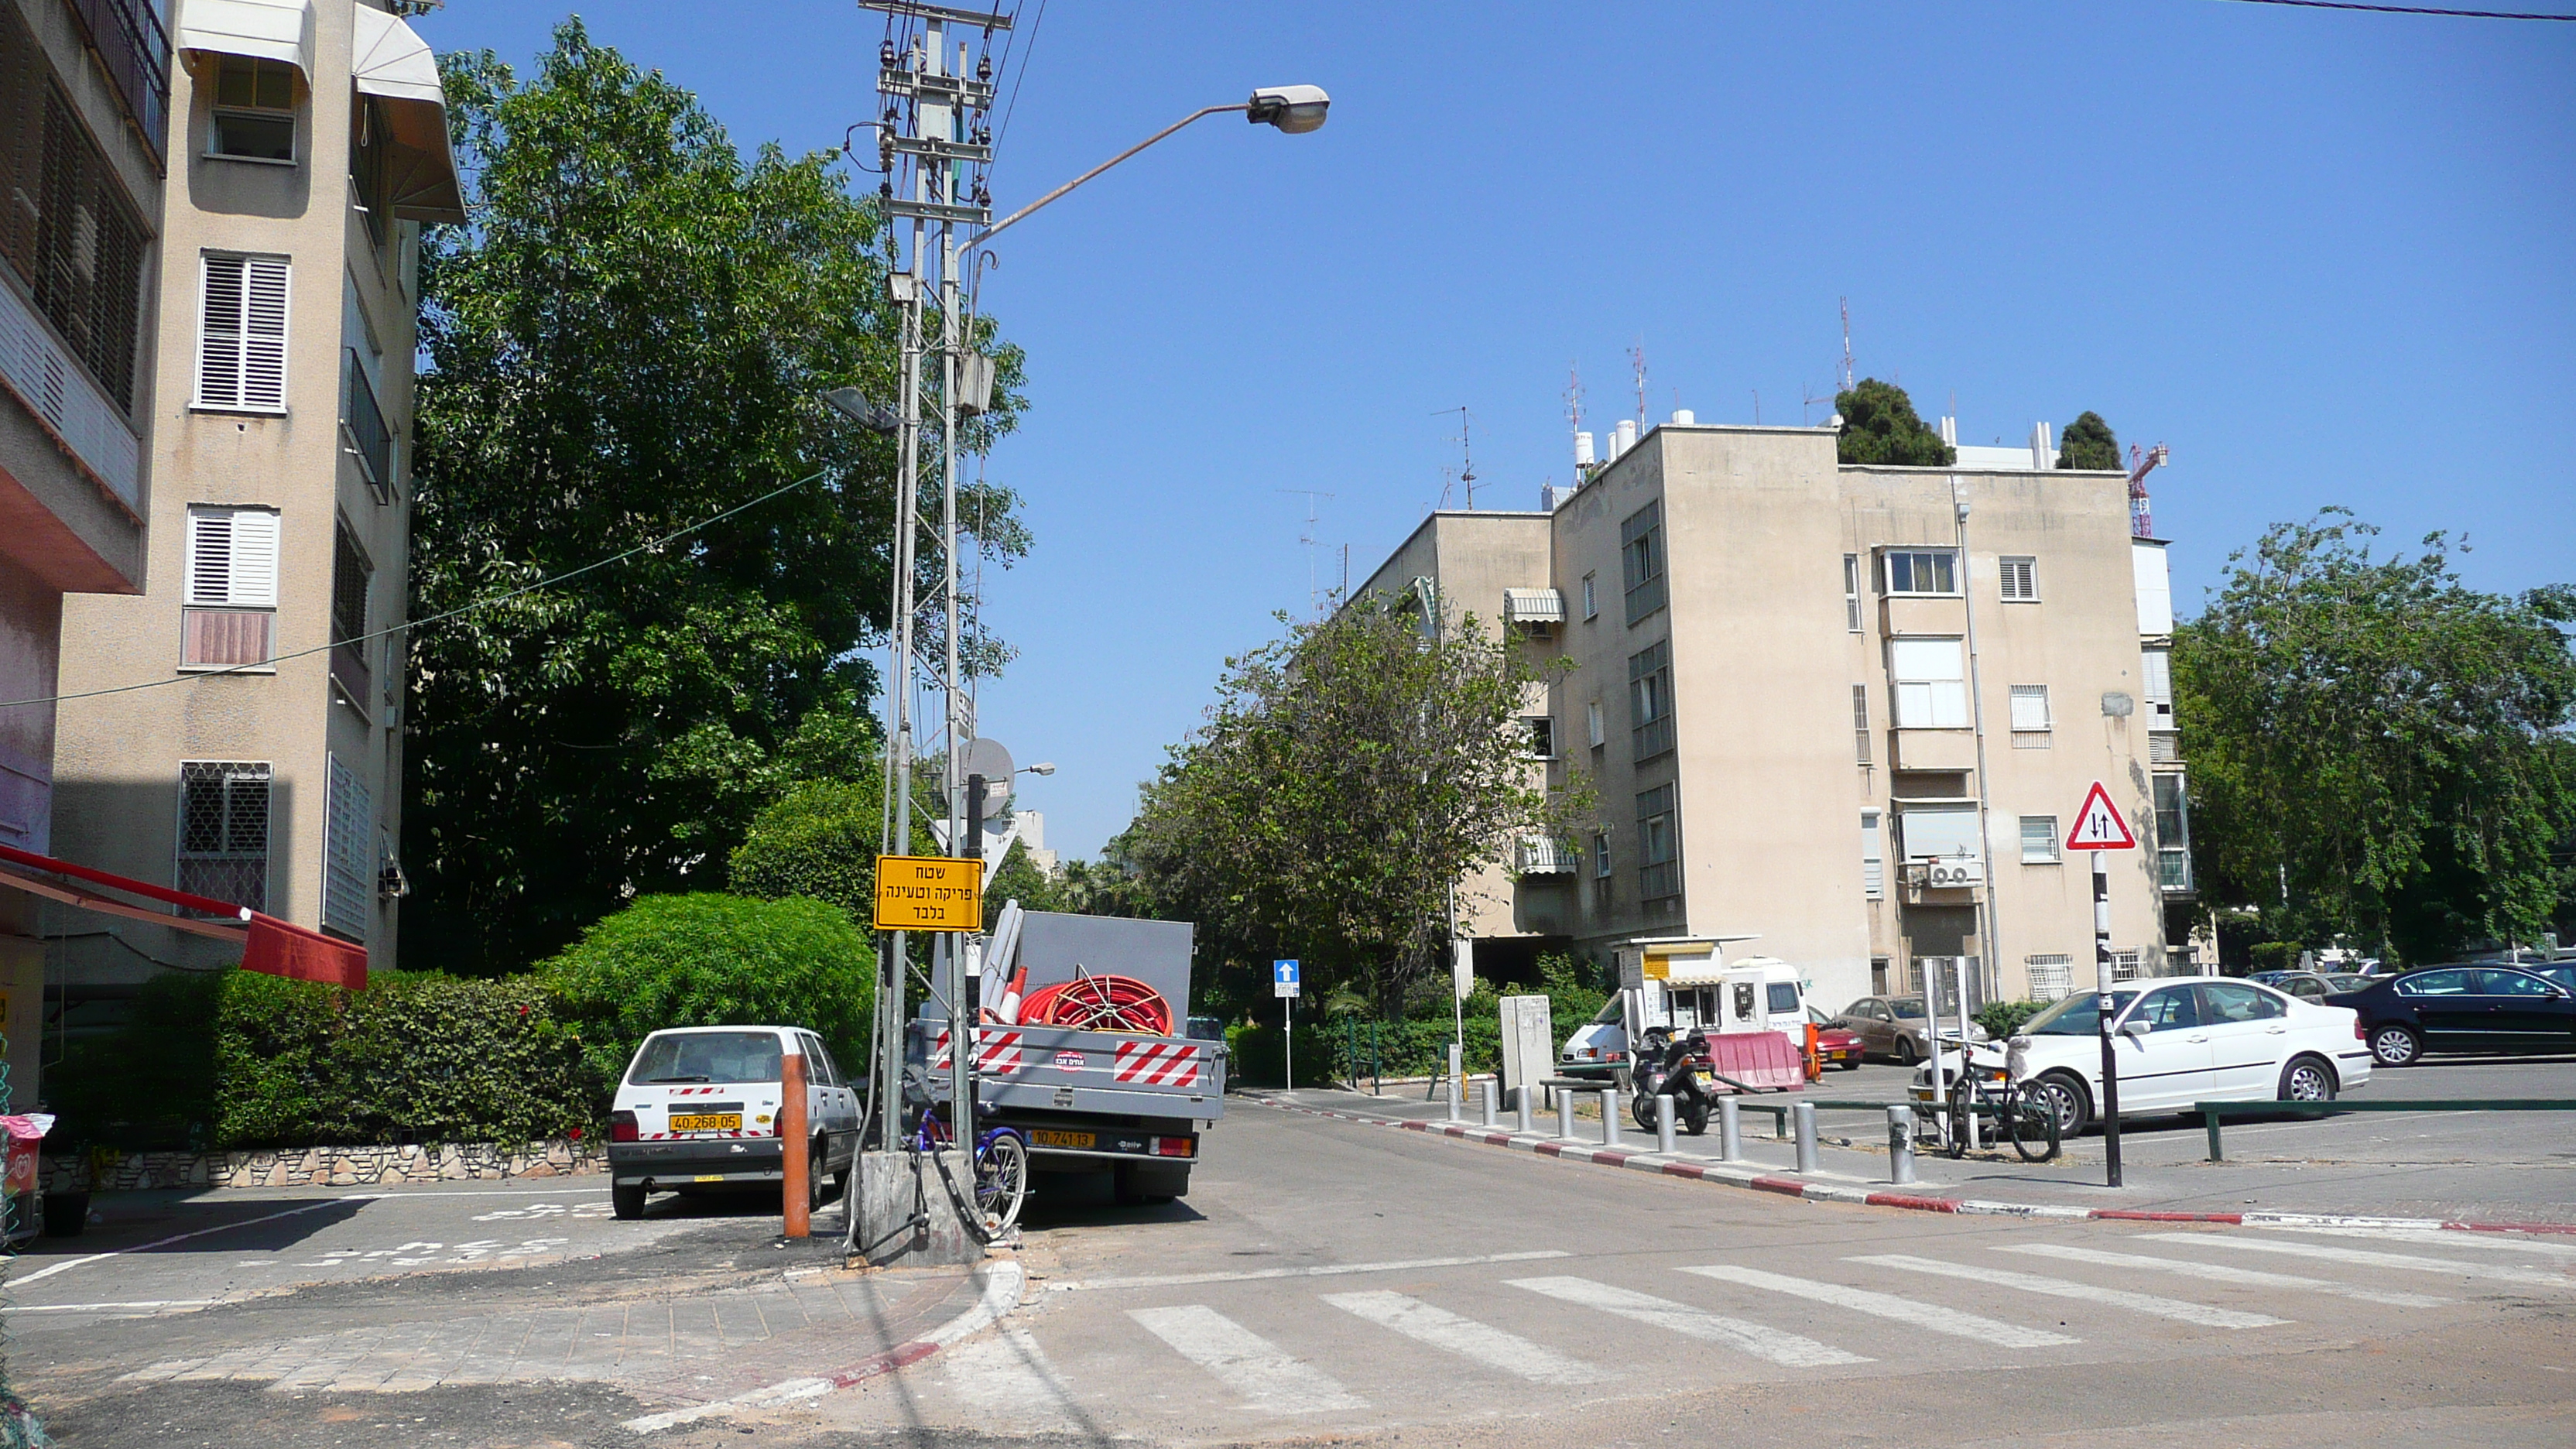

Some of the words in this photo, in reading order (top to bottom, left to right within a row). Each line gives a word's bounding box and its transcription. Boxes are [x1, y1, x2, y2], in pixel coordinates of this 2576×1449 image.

[916, 867, 945, 879] שטח
[886, 886, 930, 899] וטעינה
[934, 887, 972, 902] פריקה
[913, 905, 945, 920] בלבד
